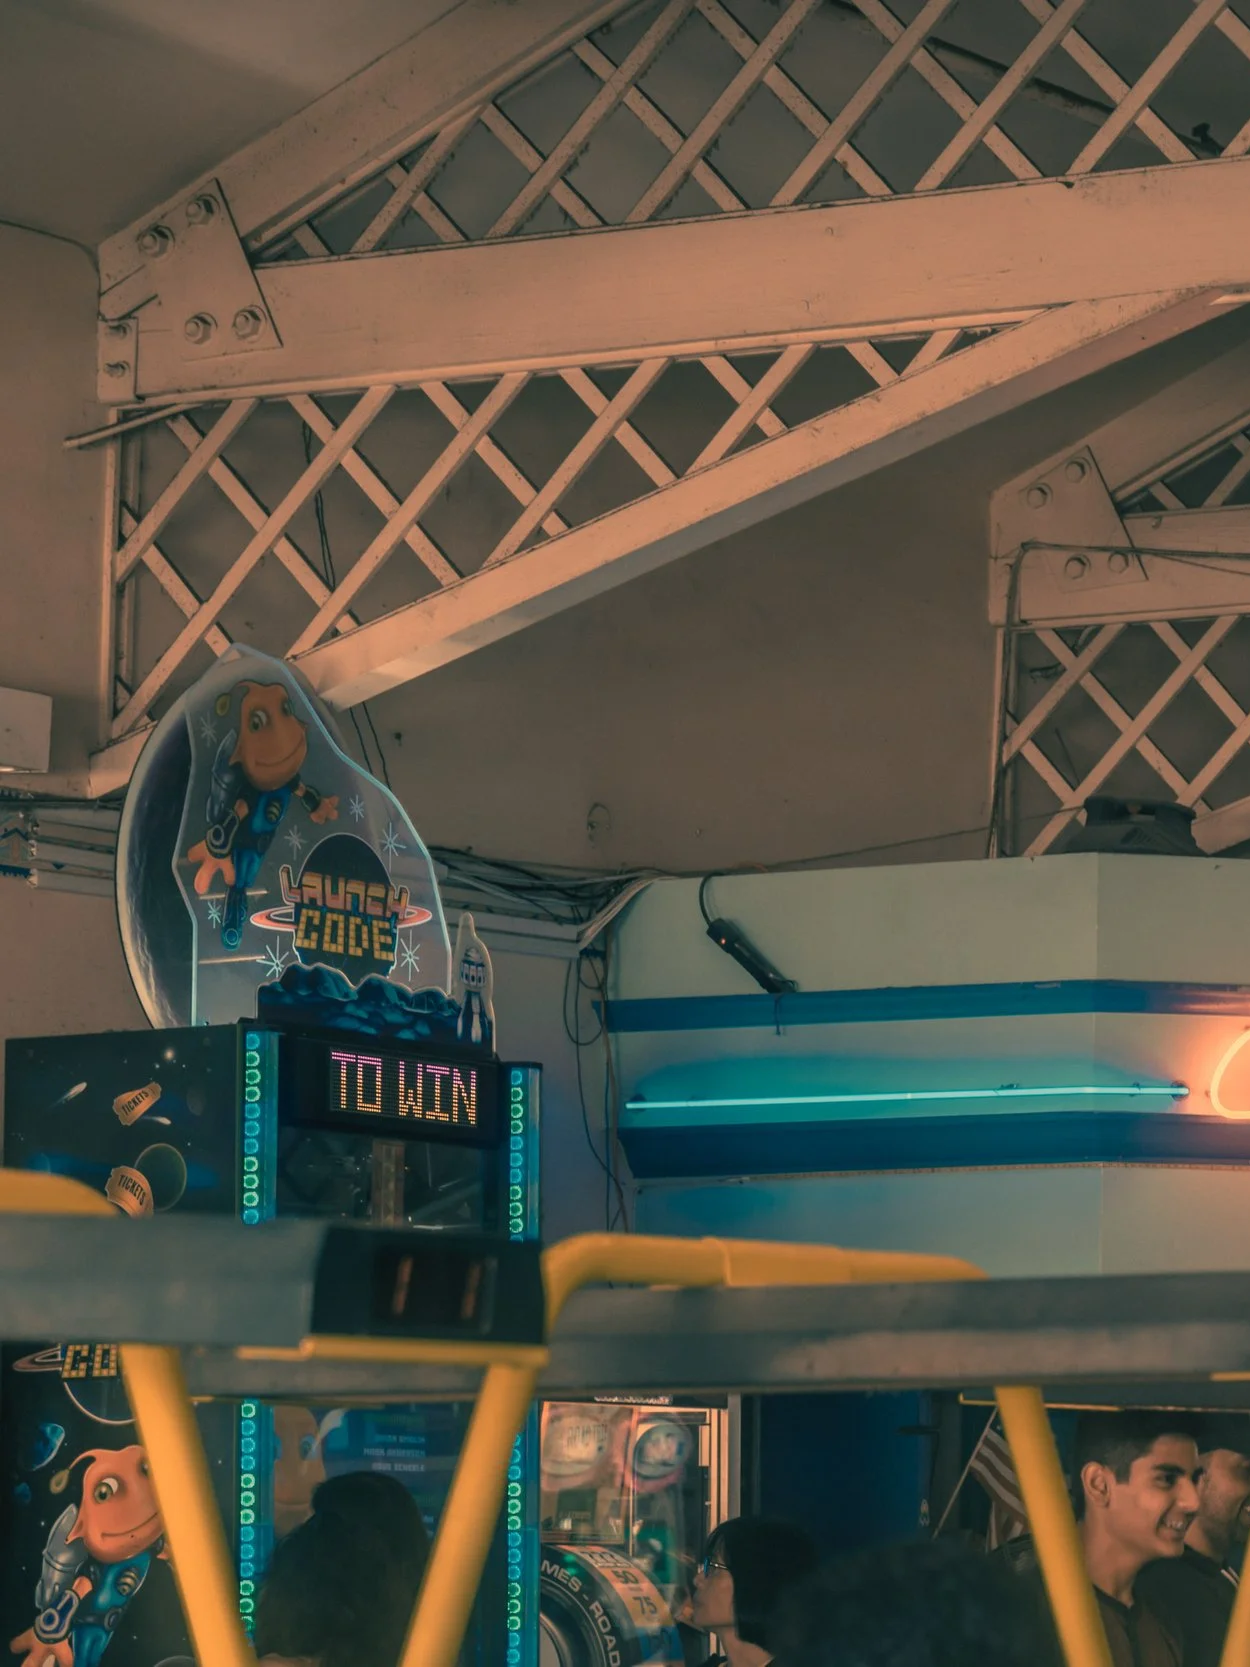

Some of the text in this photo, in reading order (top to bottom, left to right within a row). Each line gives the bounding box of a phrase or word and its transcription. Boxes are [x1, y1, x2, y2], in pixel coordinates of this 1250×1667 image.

[280, 866, 409, 921] LAUNCH
[295, 908, 395, 962] CODE
[122, 1090, 149, 1116] TICKETS
[331, 1051, 477, 1125] TO WIN
[117, 1174, 146, 1206] TICKETS
[62, 1344, 118, 1379] CO
[610, 1569, 640, 1584] 50
[541, 1560, 582, 1593] MES
[589, 1600, 621, 1667] ROAD
